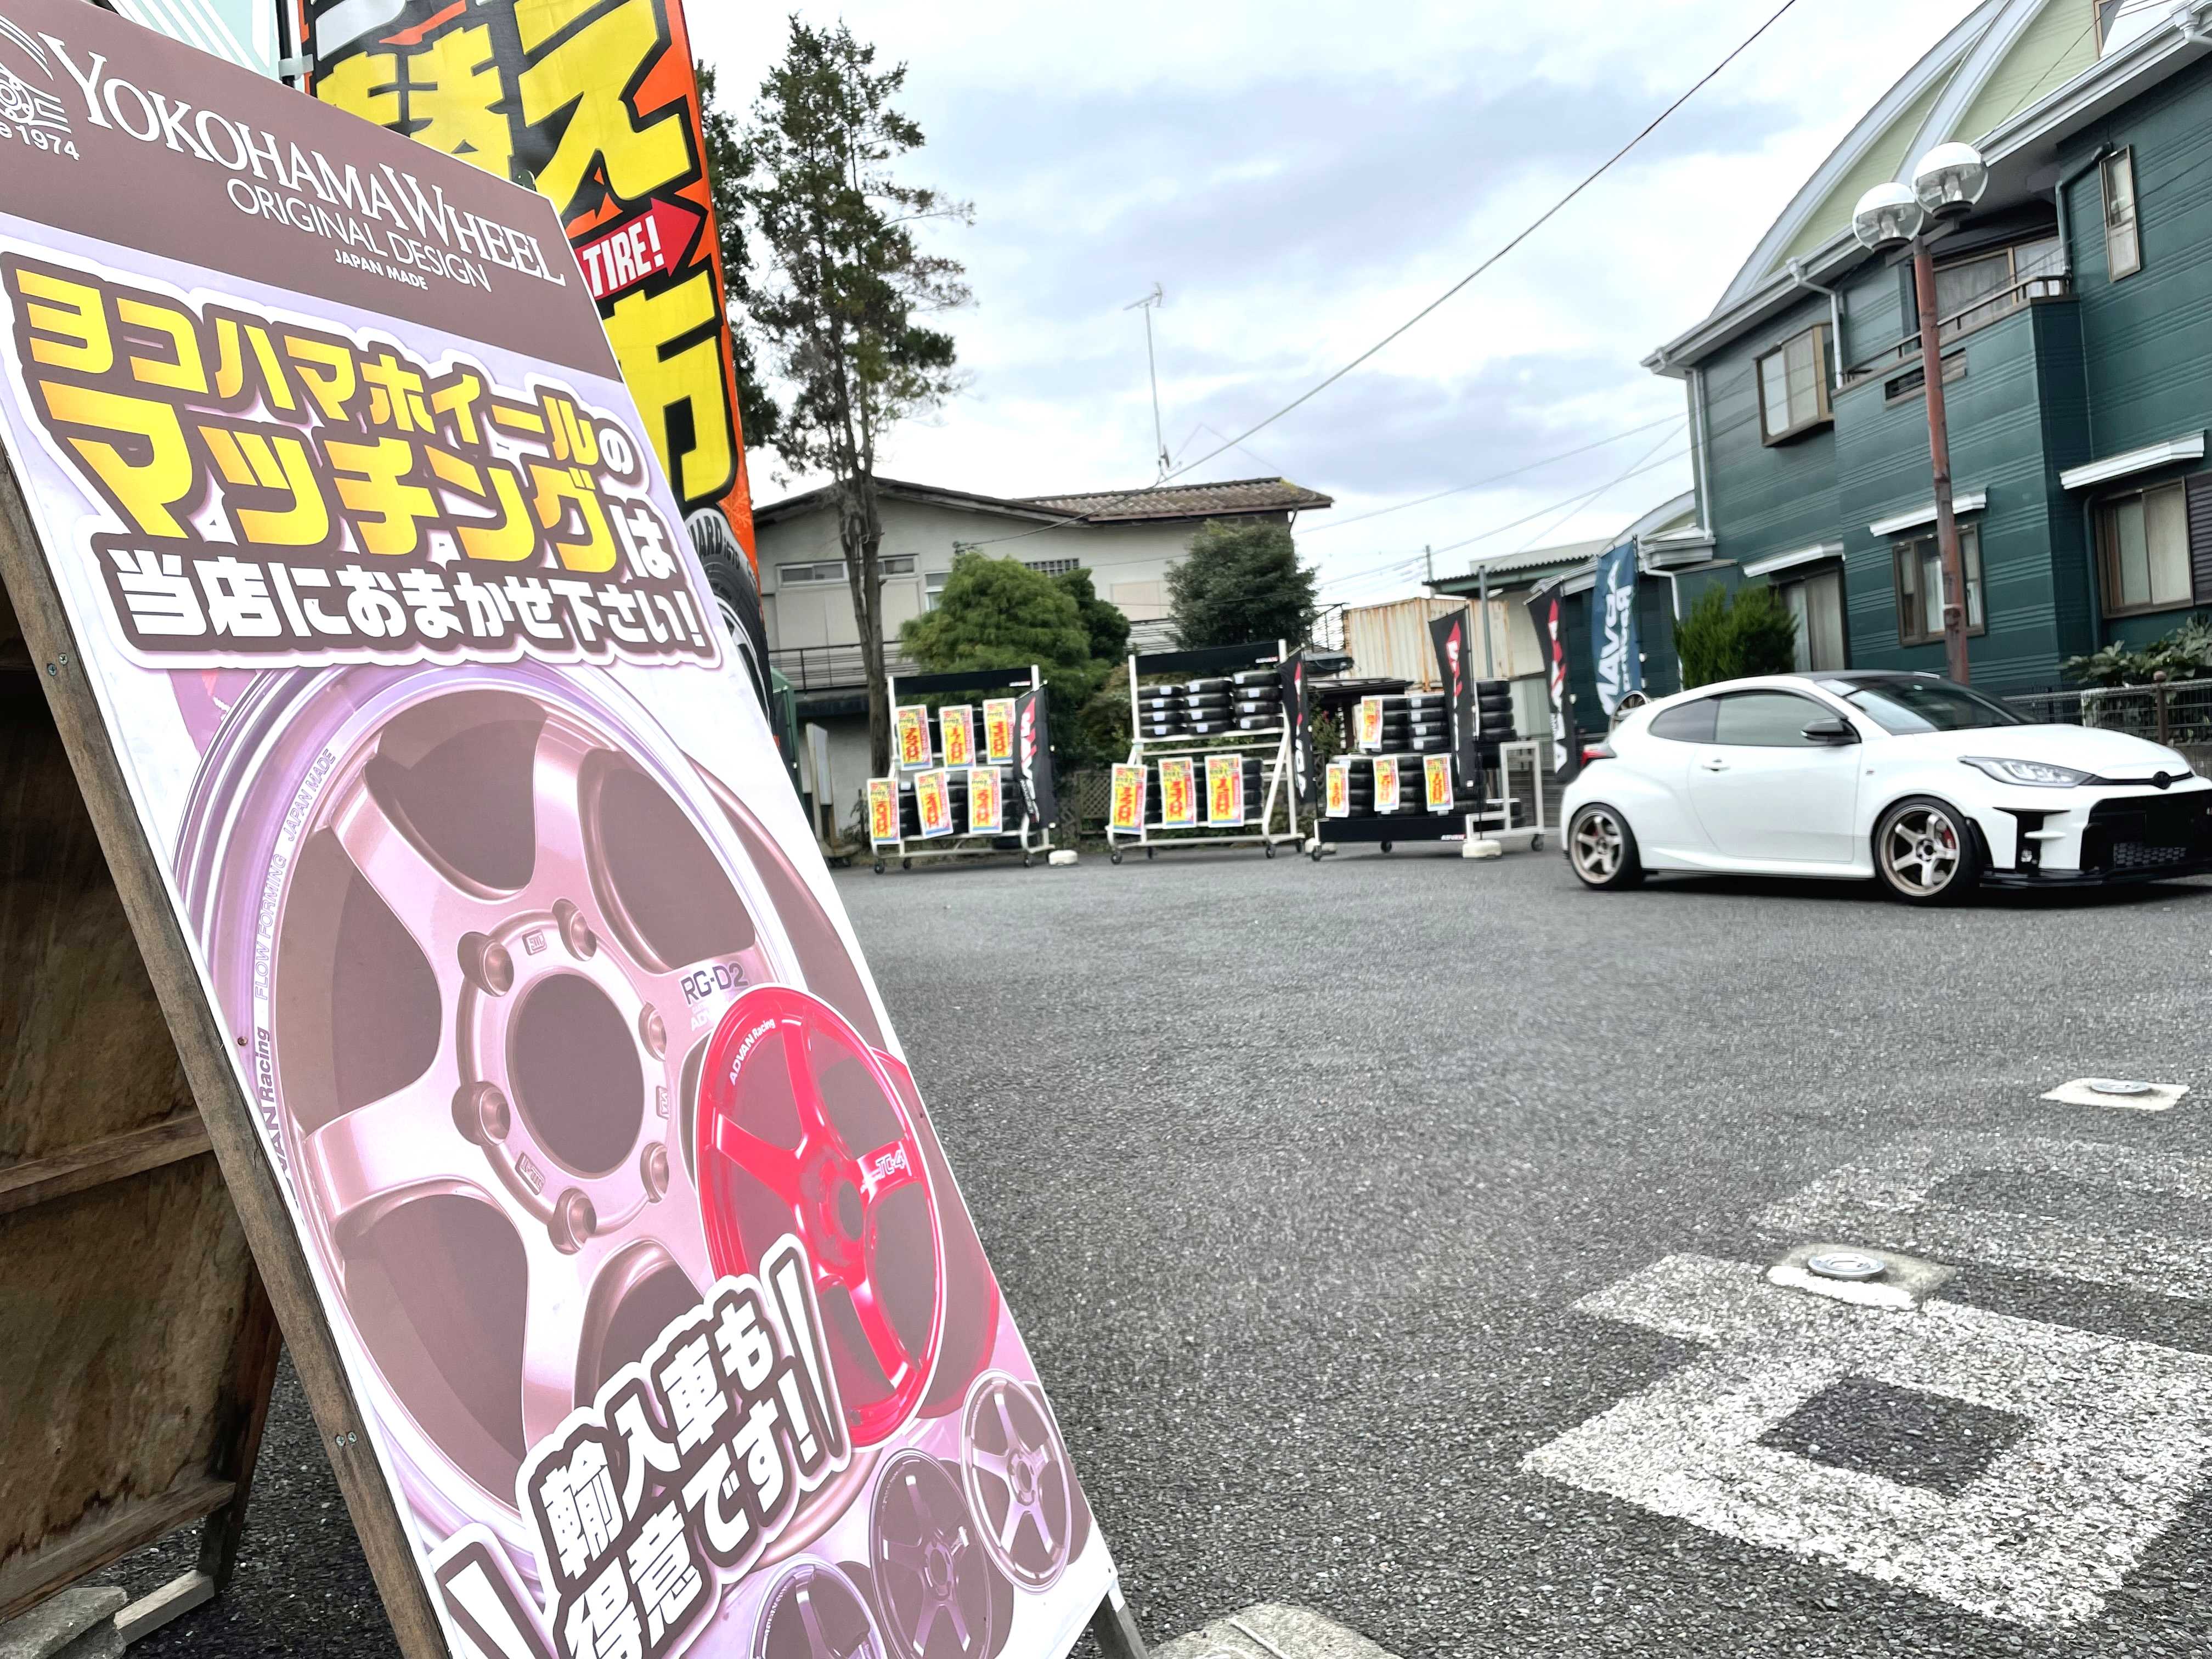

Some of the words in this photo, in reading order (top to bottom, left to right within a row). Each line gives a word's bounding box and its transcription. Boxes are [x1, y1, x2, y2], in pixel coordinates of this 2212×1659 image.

[15, 125, 80, 161] 1974
[227, 178, 389, 257] ORIGINAL
[386, 230, 492, 293] DESIGN
[334, 249, 384, 275] JAPAN
[386, 265, 428, 290] MADE
[582, 215, 665, 297] TIRE!
[15, 268, 634, 475] ヨコハマホイールの
[40, 380, 676, 580] マッチングは
[283, 789, 313, 842] JAPAN
[305, 748, 336, 792] MADE
[258, 853, 287, 939] FORMING
[255, 941, 270, 1001] FLOW
[255, 1026, 275, 1102] Racing
[729, 1033, 755, 1086] ADVAN
[752, 1018, 776, 1040] Racing
[539, 1302, 775, 1580] 輸入車も
